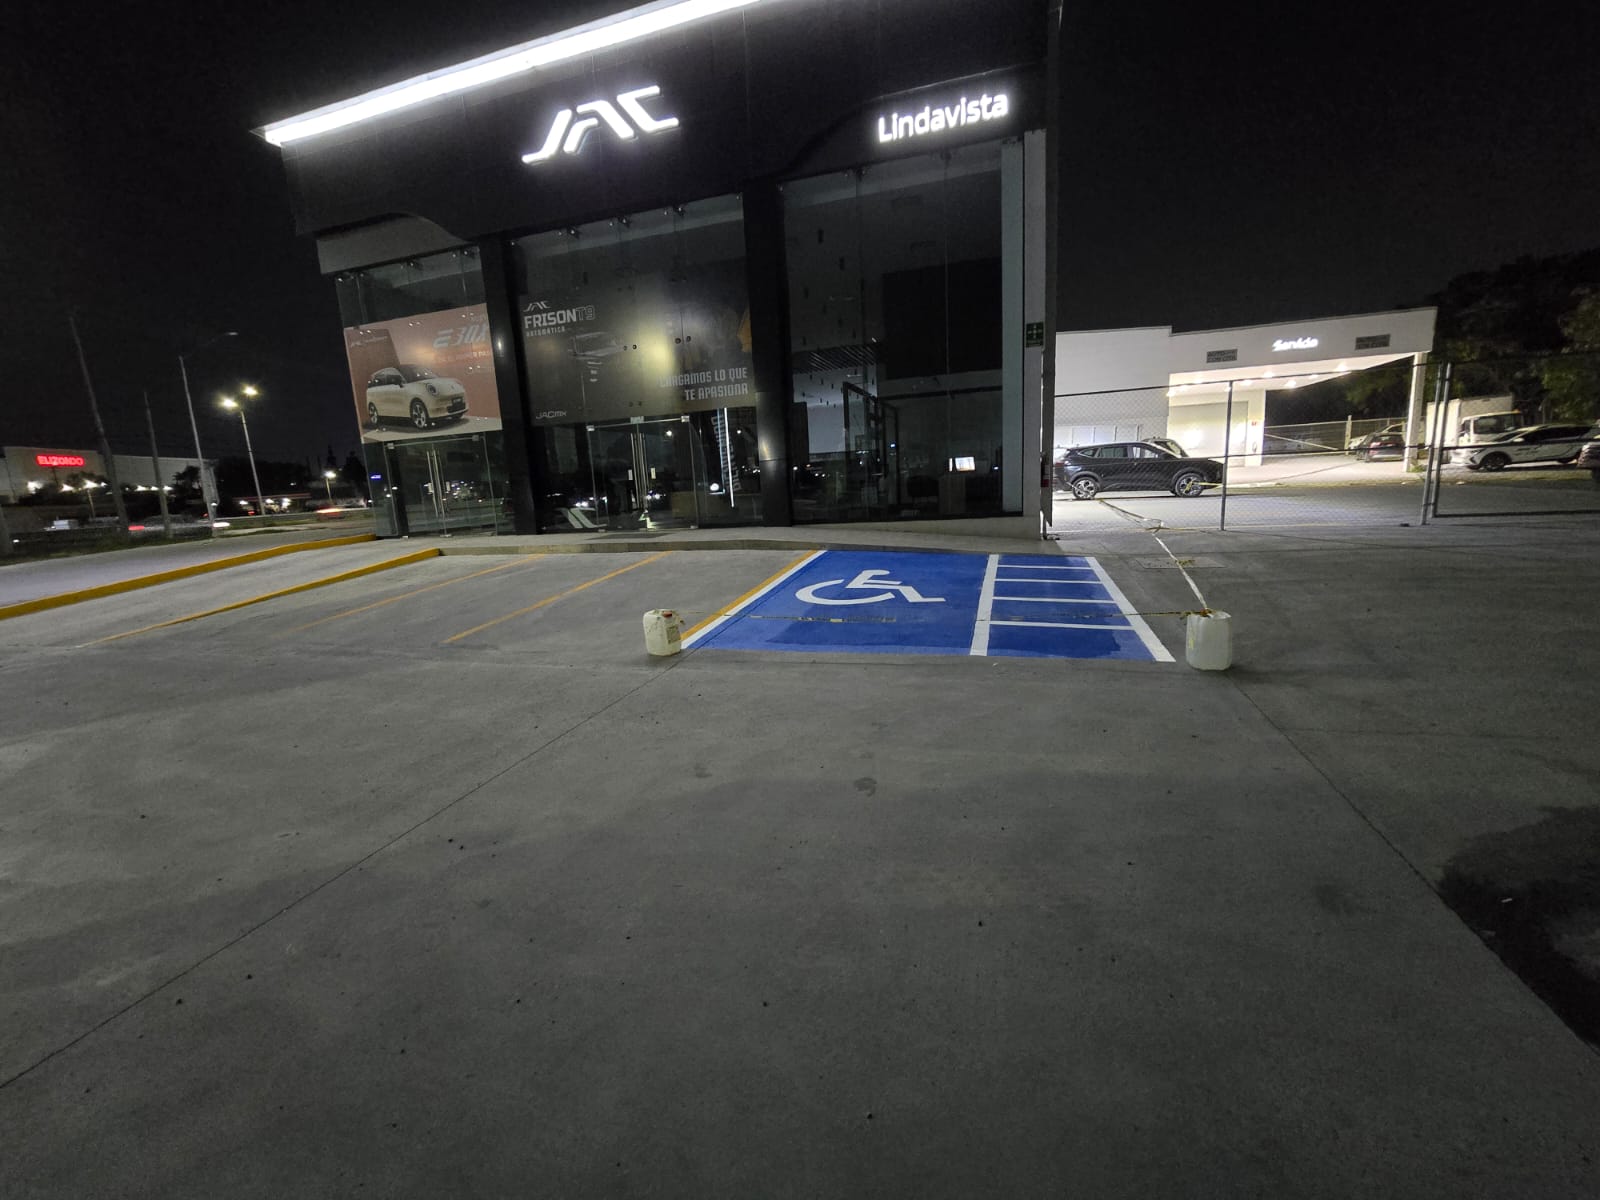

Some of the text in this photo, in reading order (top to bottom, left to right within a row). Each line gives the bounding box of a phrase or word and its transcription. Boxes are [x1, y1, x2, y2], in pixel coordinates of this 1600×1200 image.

[522, 85, 680, 164] JAC
[877, 91, 1010, 143] Lindavista
[684, 383, 748, 400] TE APASIONA
[714, 369, 726, 381] LO
[728, 367, 748, 382] QUE
